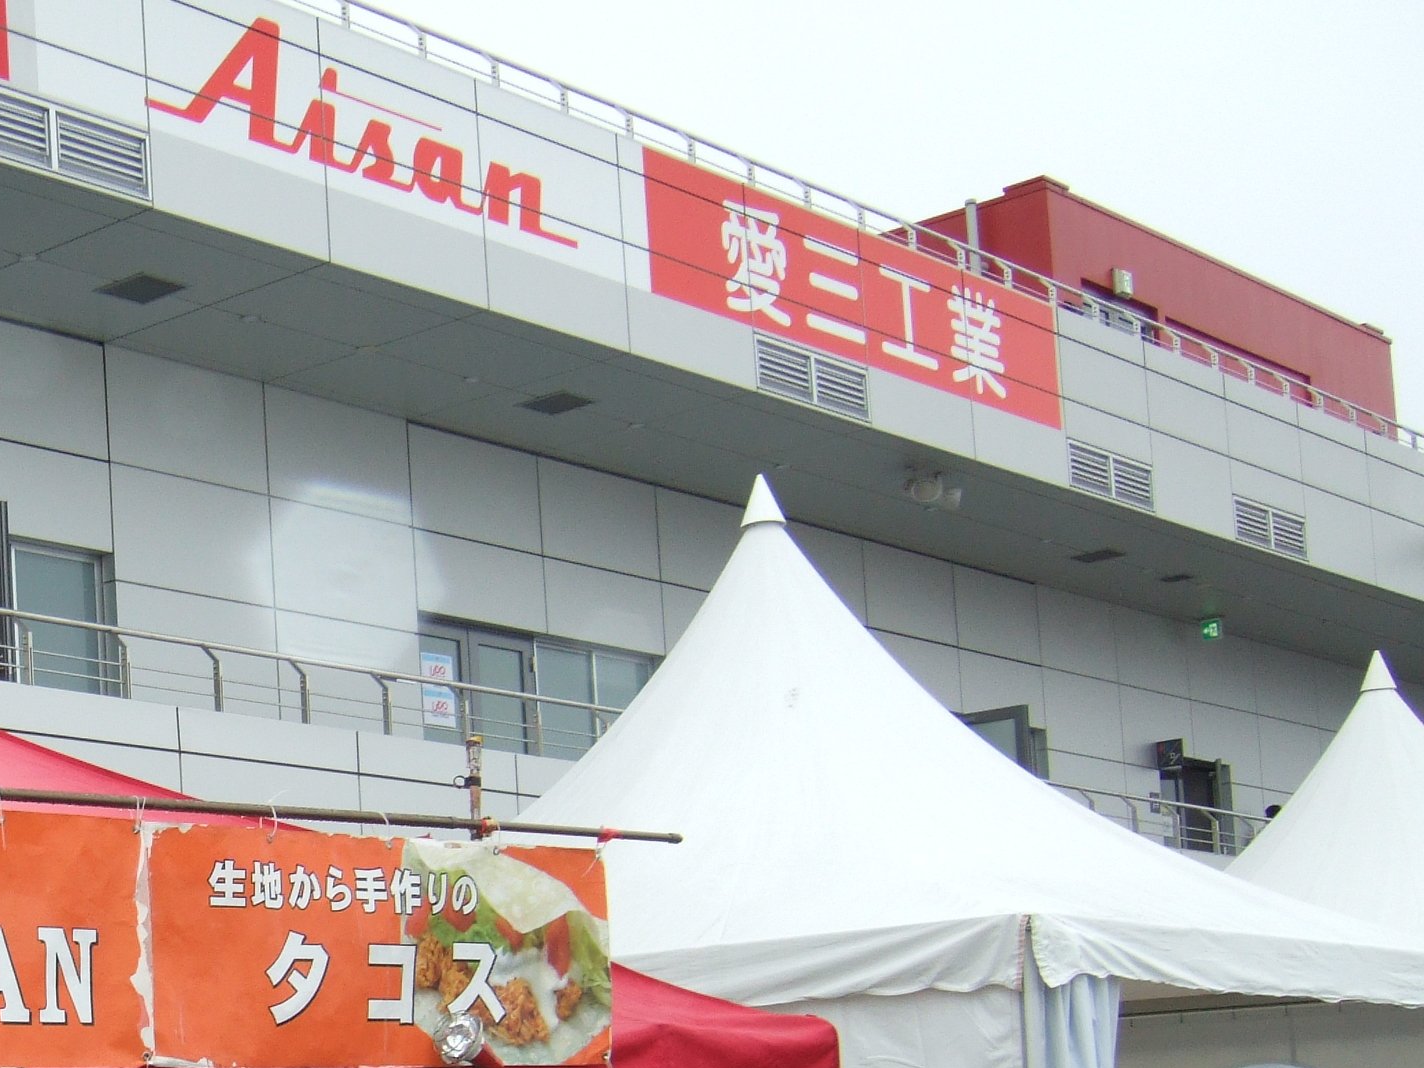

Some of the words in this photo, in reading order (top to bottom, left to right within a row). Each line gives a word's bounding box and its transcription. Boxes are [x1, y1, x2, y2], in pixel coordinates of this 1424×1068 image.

[145, 17, 578, 248] Aisan
[720, 199, 1007, 400] 愛三工業
[208, 859, 479, 915] 生地から手作りの
[266, 930, 506, 1025] タコス
